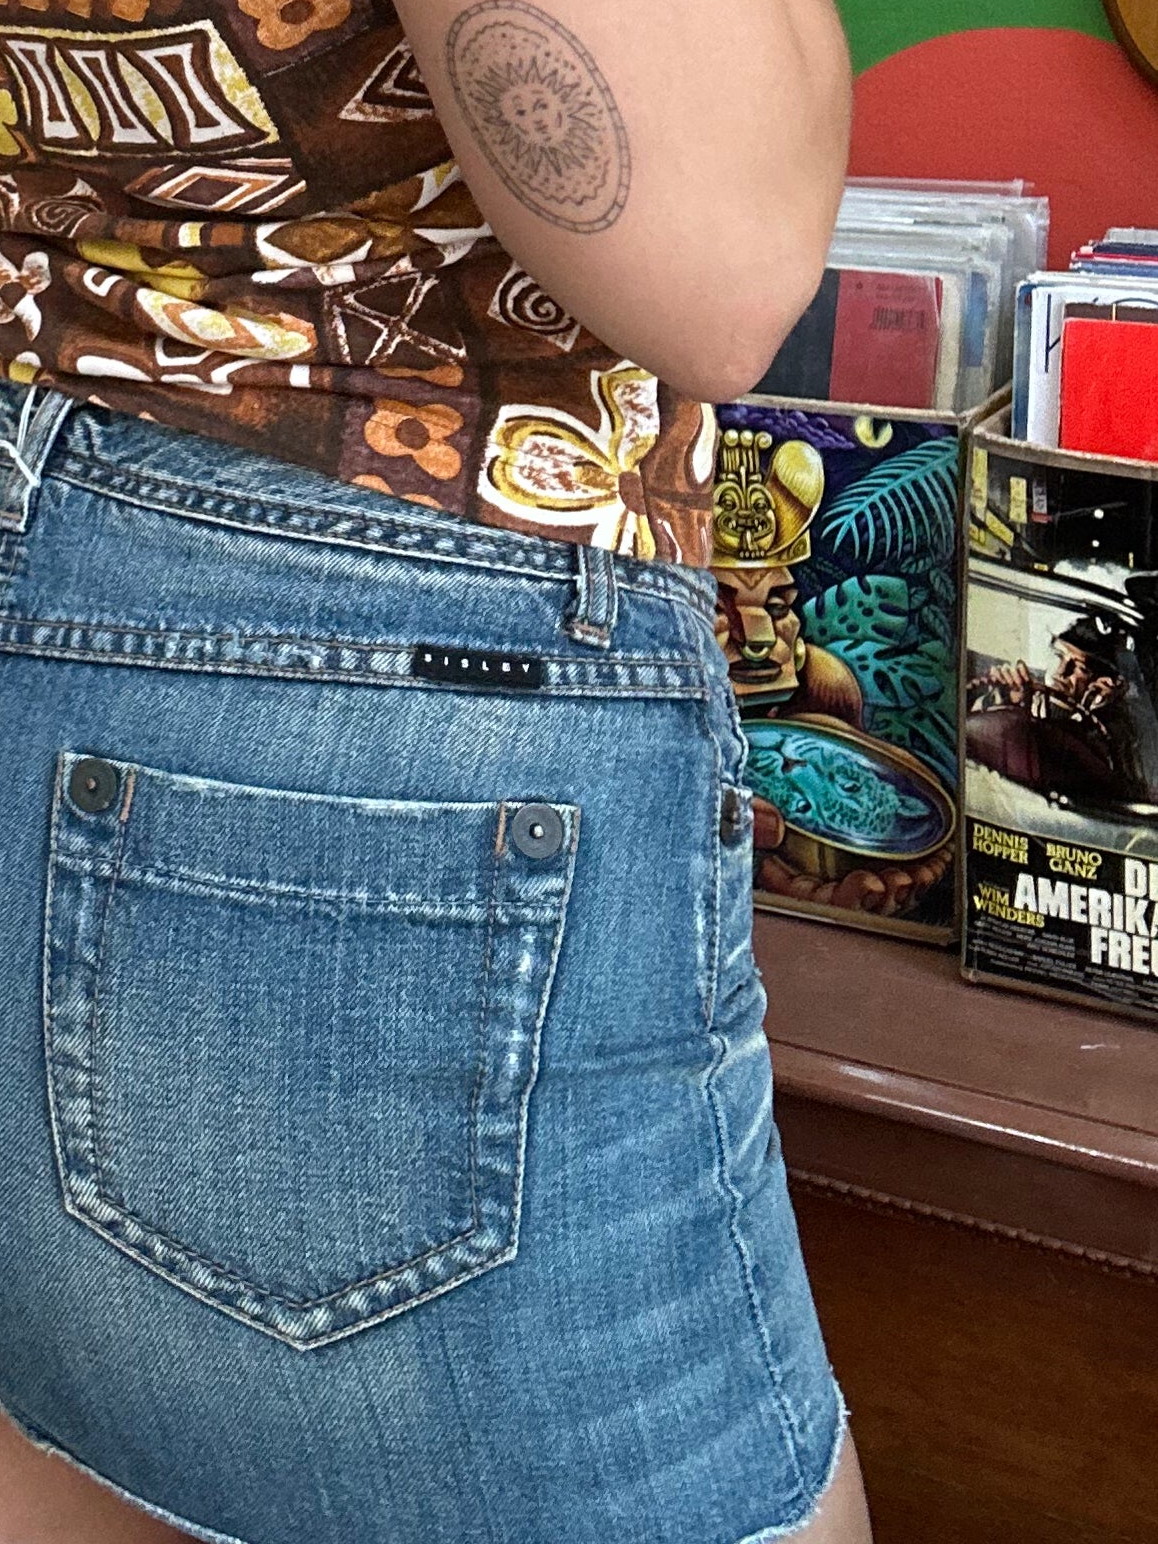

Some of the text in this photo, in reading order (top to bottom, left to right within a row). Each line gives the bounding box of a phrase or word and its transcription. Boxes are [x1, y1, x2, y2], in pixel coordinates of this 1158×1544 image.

[972, 835, 1029, 865] HOPPER
[973, 823, 1029, 851] DENNIS
[1045, 842, 1102, 866] BRUNO
[1049, 857, 1098, 880] GANZ
[978, 882, 1010, 908] WIM
[973, 895, 1045, 929] WENDERS
